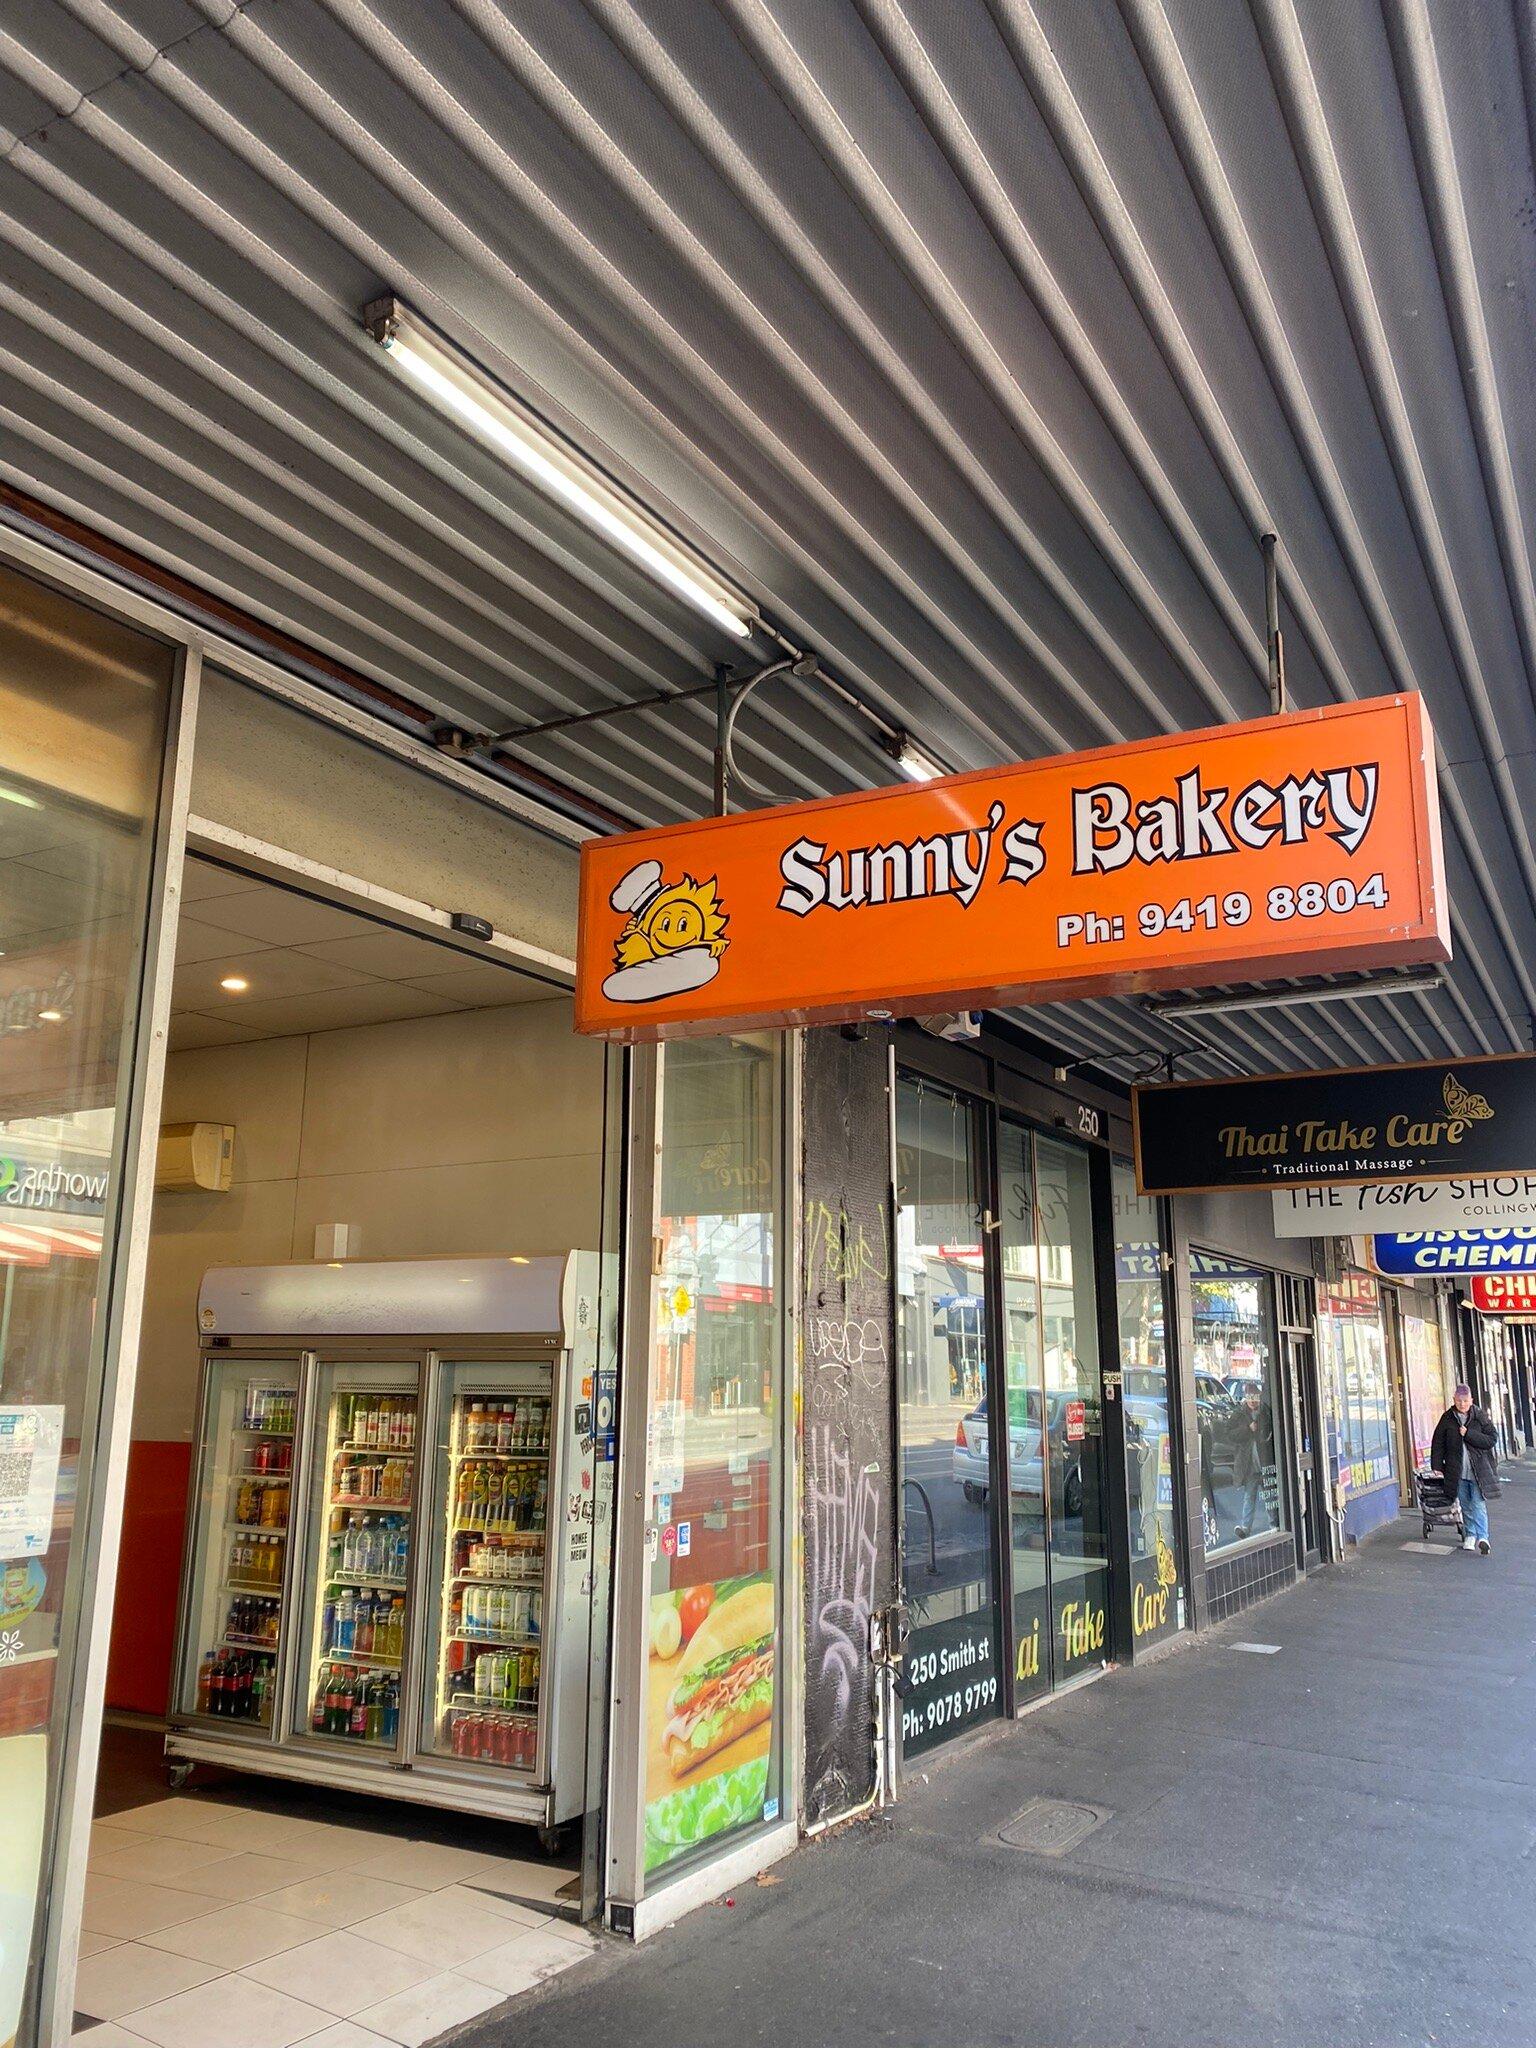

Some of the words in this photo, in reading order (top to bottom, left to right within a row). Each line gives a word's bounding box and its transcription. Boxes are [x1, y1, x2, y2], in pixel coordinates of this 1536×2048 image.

[776, 800, 1046, 918] Sunny's
[1072, 762, 1379, 876] Bakery
[1057, 911, 1125, 947] Ph:
[1138, 892, 1251, 936] 9419
[1267, 873, 1388, 921] 8804
[1078, 1105, 1098, 1136] 250
[1218, 1125, 1288, 1157] Thai
[1295, 1121, 1376, 1152] Take
[1386, 1115, 1463, 1147] Care
[1273, 1160, 1349, 1174] Traditional
[1355, 1157, 1413, 1171] Massage
[1286, 1186, 1343, 1209] THE
[1103, 1374, 1121, 1383] PUSH
[1061, 1601, 1104, 1661] Take
[1134, 1583, 1166, 1636] Care
[910, 1653, 937, 1686] 250
[940, 1638, 976, 1673] Smith
[978, 1637, 989, 1661] st
[902, 1712, 923, 1740] Ph:
[927, 1696, 962, 1729] 9078
[965, 1678, 997, 1713] 9799
